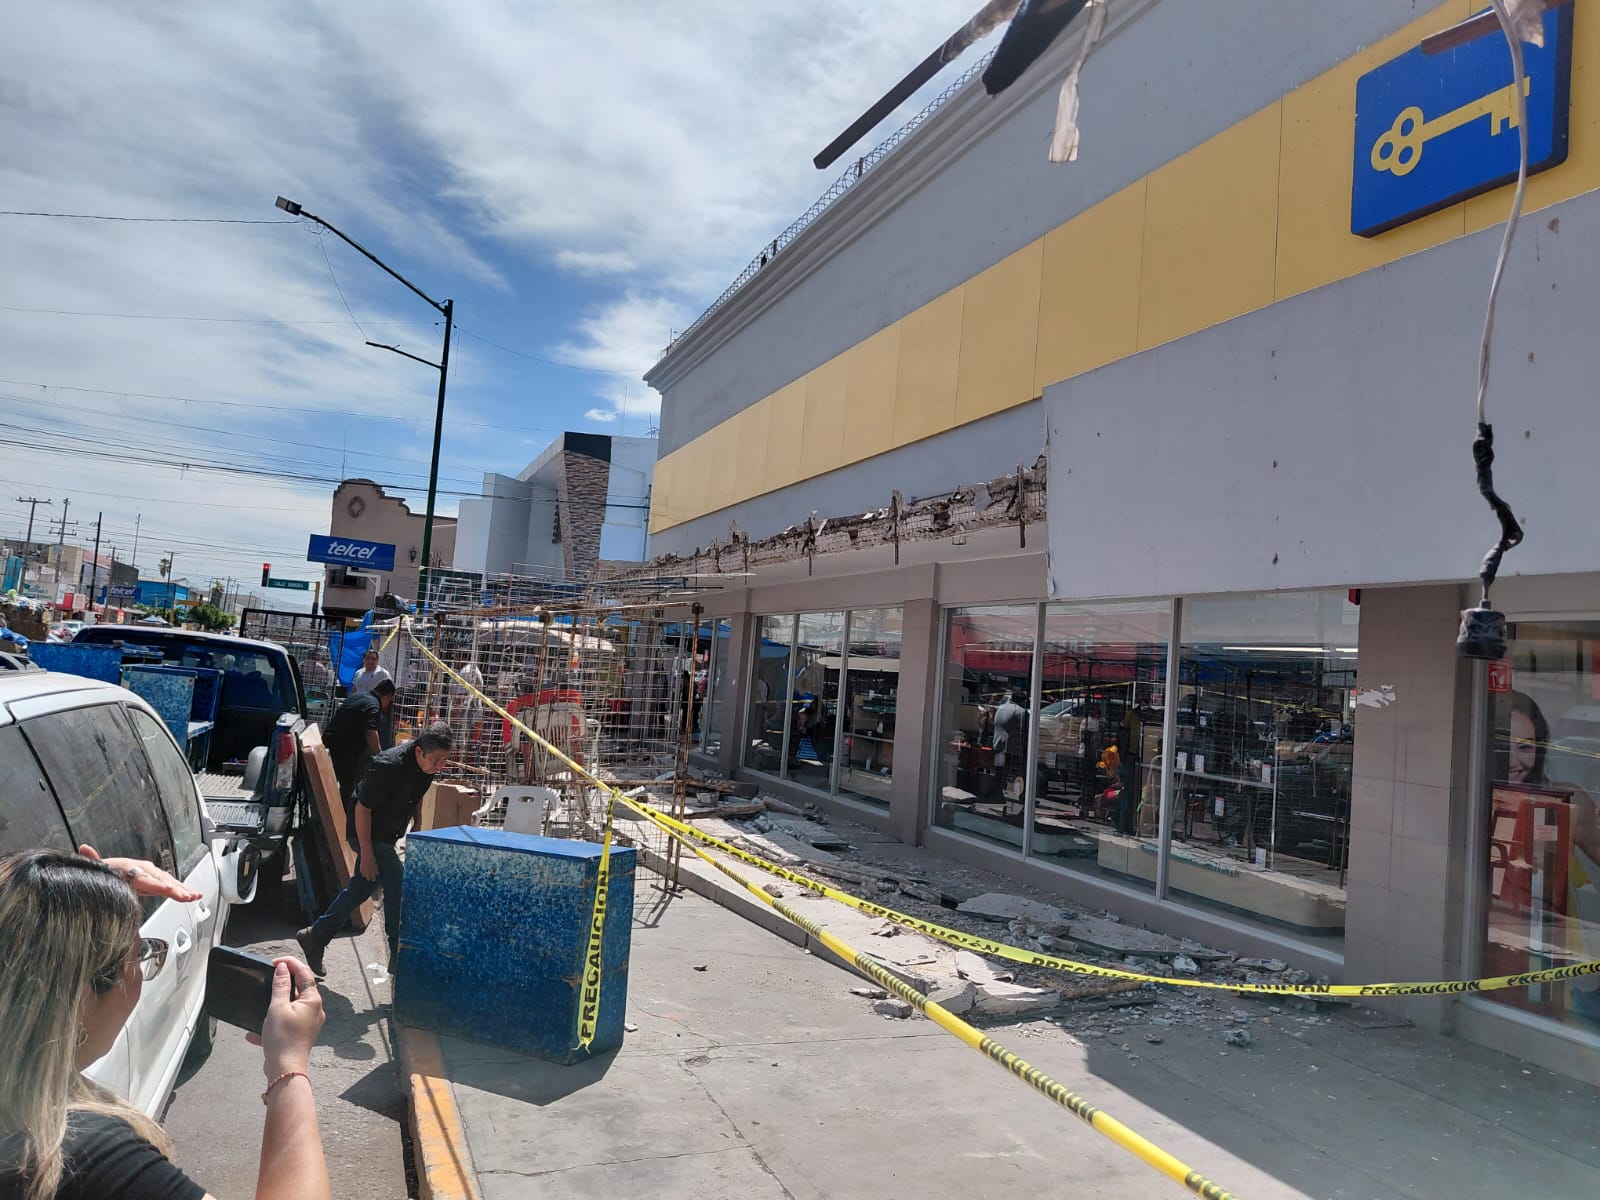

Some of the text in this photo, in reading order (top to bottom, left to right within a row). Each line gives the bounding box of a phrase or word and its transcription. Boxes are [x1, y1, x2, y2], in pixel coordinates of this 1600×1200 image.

[327, 541, 376, 559] telcel
[110, 586, 136, 596] telcel
[580, 870, 607, 1039] PRECAUCION
